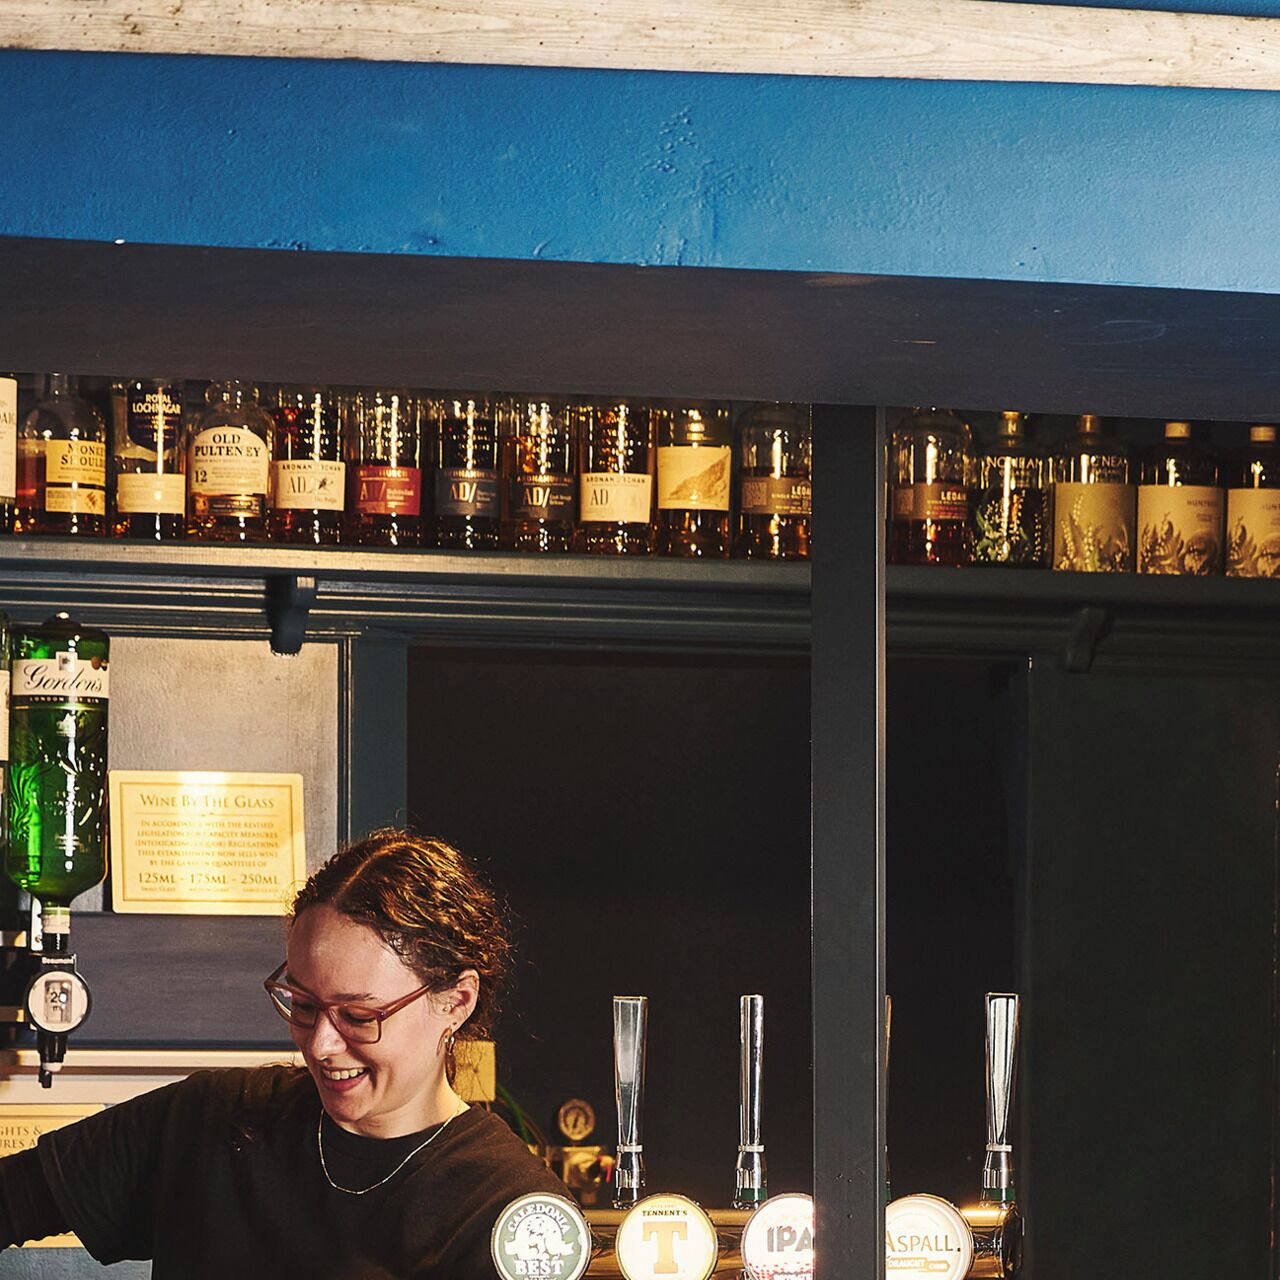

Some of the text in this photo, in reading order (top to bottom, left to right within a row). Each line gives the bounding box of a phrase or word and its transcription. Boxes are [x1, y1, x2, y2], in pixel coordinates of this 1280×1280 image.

[212, 433, 241, 444] OLD
[194, 445, 260, 457] PULTENEY
[194, 469, 207, 483] 12
[23, 663, 103, 692] Gordon's
[507, 1203, 571, 1235] CALEDONIA
[642, 1209, 688, 1217] TENNENT'S
[642, 1221, 688, 1274] T
[767, 1226, 813, 1252] IPA
[513, 1259, 565, 1276] BEST
